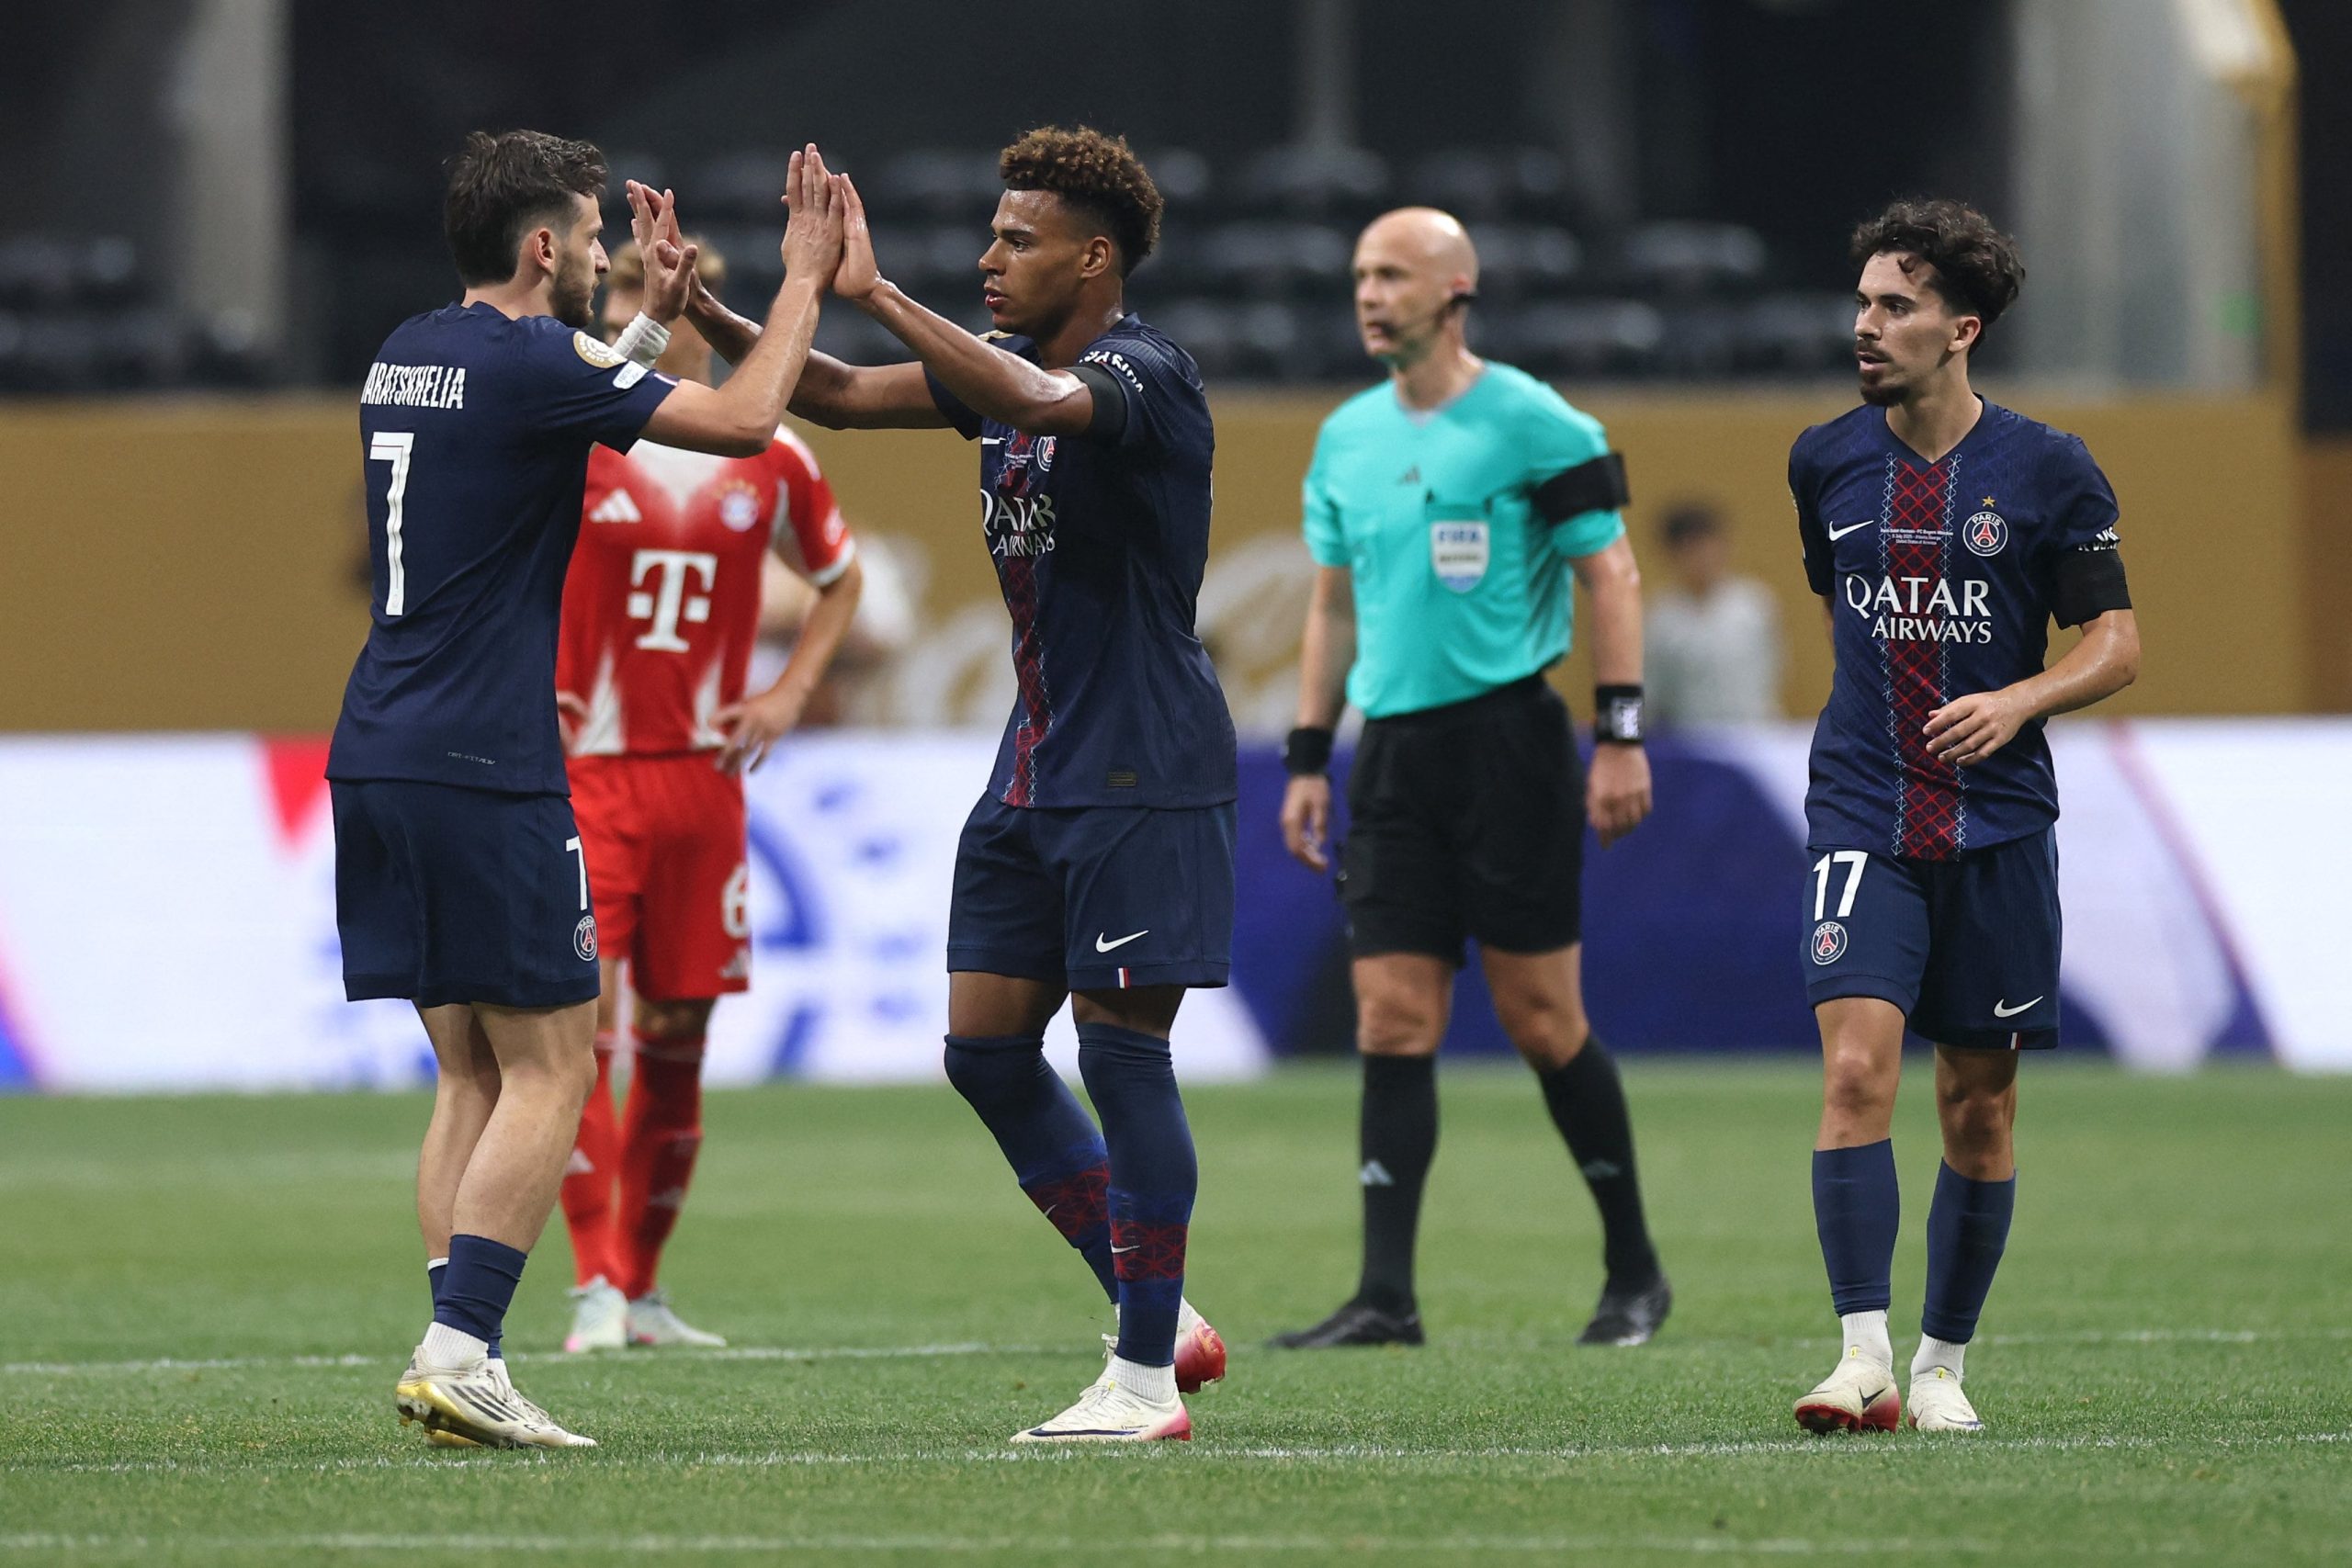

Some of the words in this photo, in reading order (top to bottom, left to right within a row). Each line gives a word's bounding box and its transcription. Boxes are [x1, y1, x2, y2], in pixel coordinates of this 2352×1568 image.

[360, 361, 466, 410] ARATSKHELIA
[369, 431, 414, 616] 7
[1972, 513, 2002, 526] PARIS
[628, 549, 717, 652] T
[1846, 573, 1992, 619] QATAR
[1871, 615, 1992, 644] AIRWAYS
[1813, 851, 1869, 921] 17
[1815, 924, 1840, 937] PARIS
